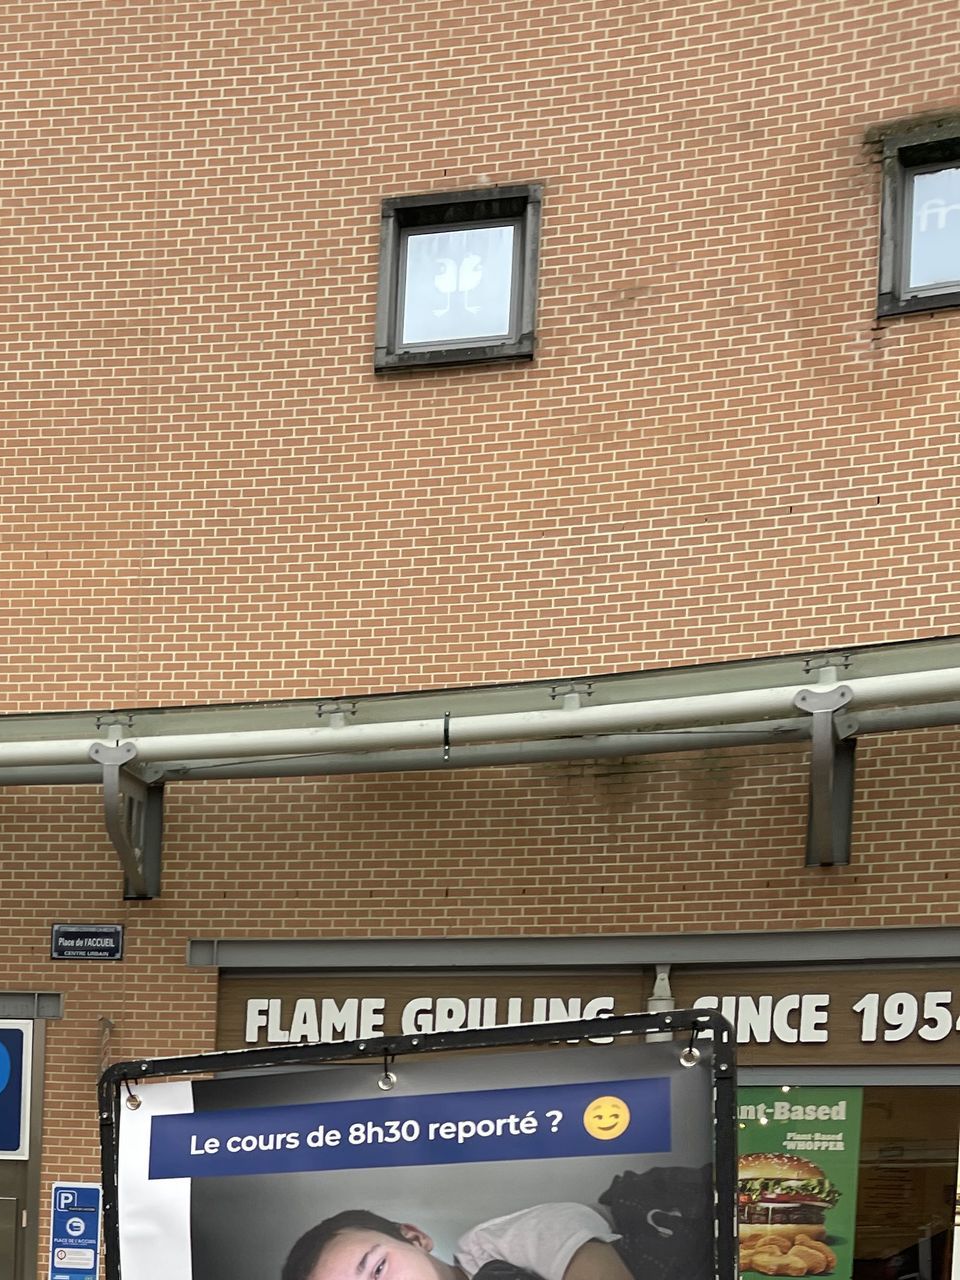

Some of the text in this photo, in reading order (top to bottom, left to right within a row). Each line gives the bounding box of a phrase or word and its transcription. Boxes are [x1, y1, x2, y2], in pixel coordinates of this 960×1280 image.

[58, 937, 75, 947] Place
[75, 938, 84, 947] de
[245, 997, 386, 1044] FLAME
[852, 991, 960, 1042] 195
[737, 1101, 847, 1120] nt-Based
[190, 1110, 564, 1155] Le cours de 8h30 reporté ?
[783, 1141, 845, 1150] WHOPPER
[60, 1193, 73, 1208] P
